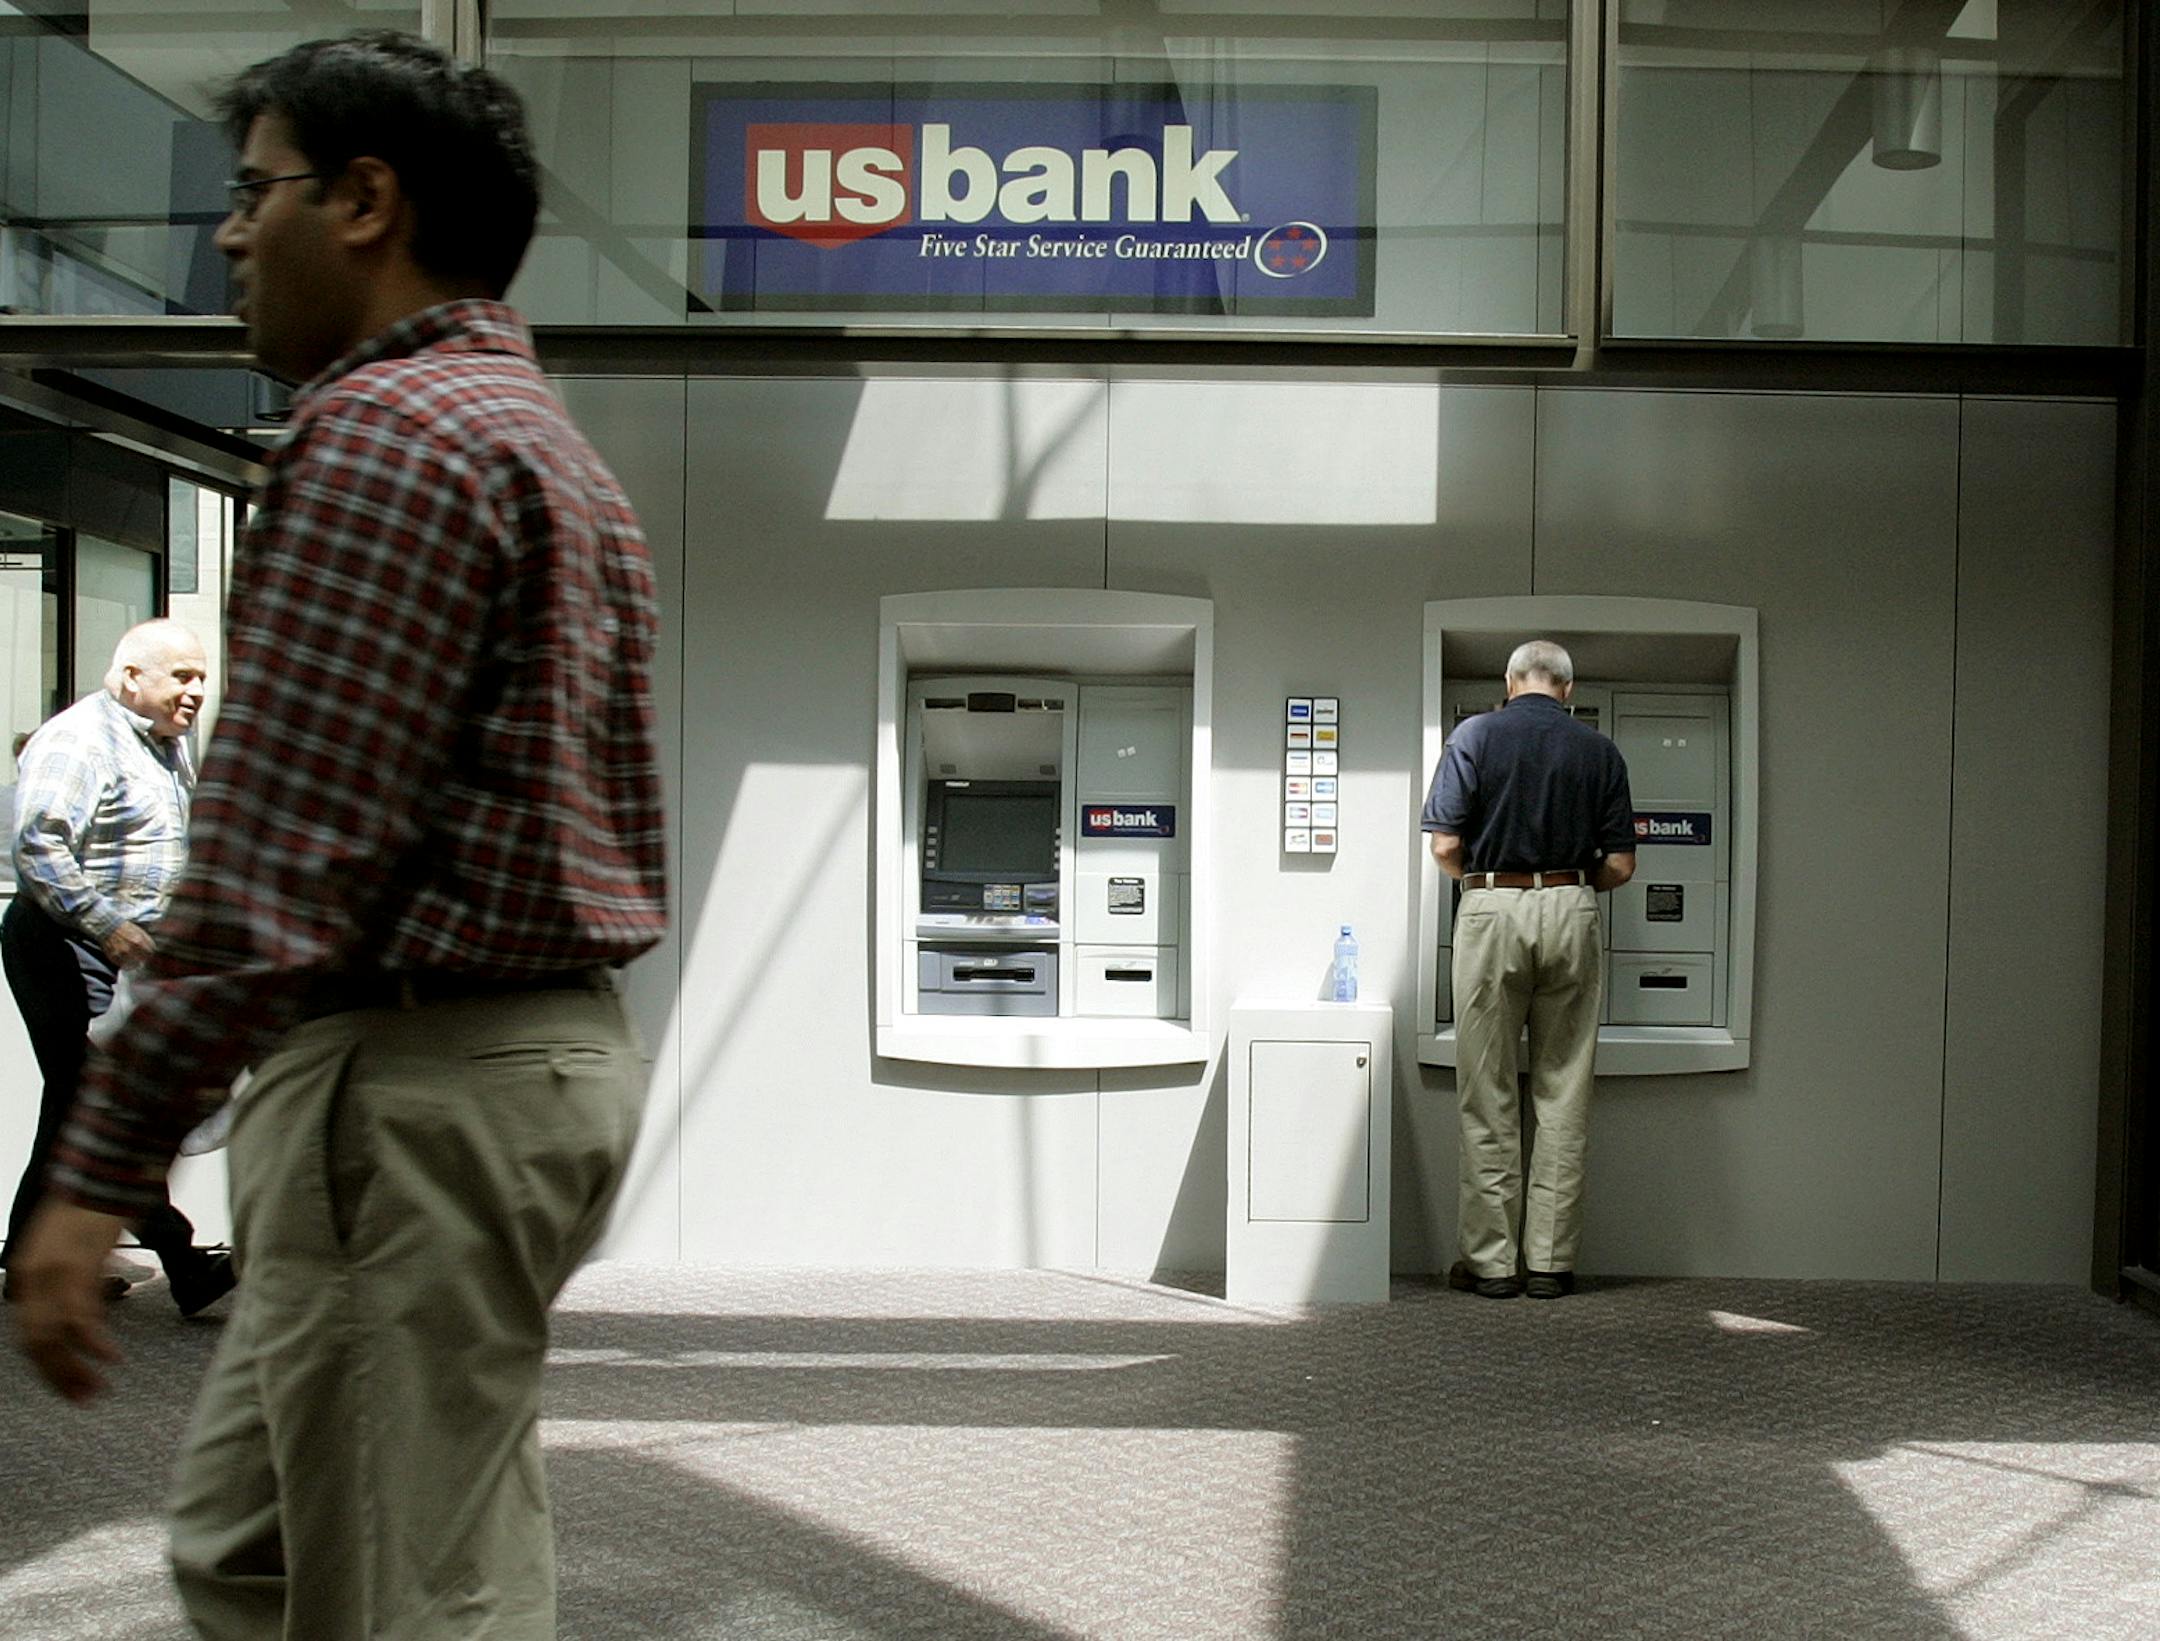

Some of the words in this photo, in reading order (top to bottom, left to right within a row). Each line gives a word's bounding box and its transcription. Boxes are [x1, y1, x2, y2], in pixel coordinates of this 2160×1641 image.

[919, 233, 968, 258] Five
[972, 233, 1021, 258] Star
[1026, 233, 1108, 259] Service
[1114, 233, 1252, 259] Guaranteed
